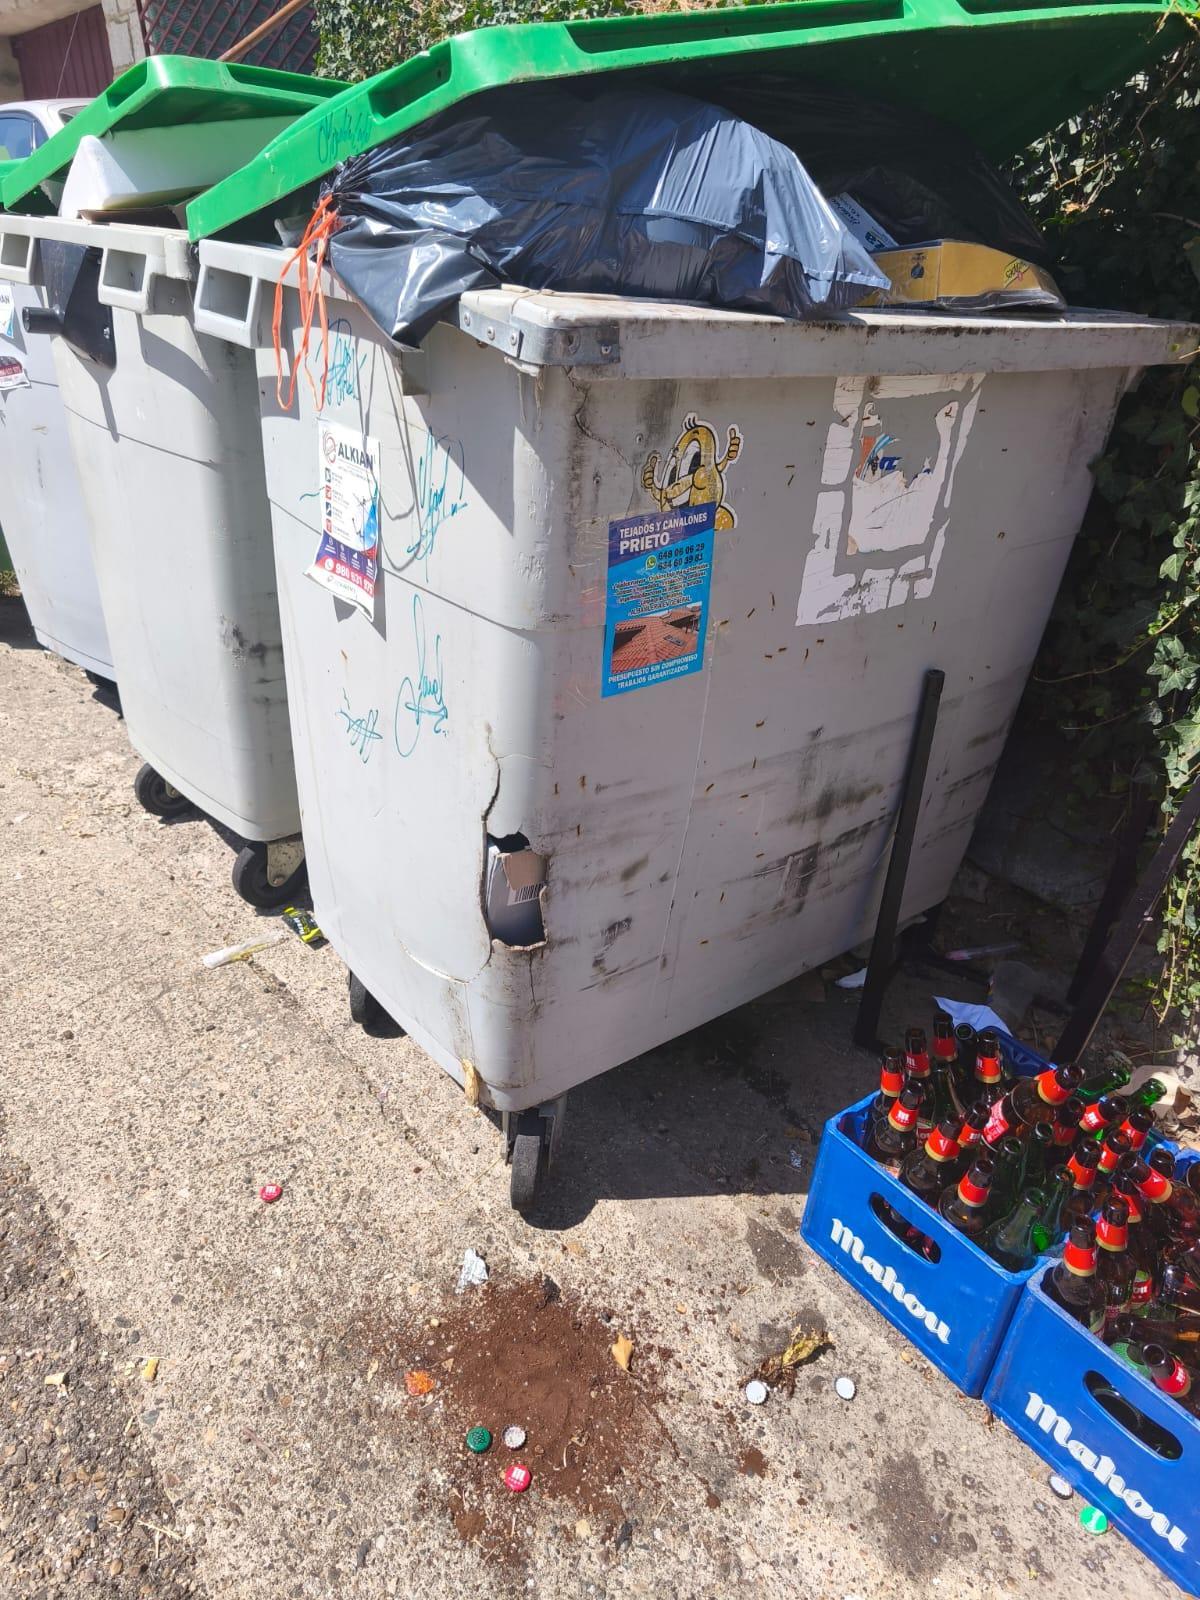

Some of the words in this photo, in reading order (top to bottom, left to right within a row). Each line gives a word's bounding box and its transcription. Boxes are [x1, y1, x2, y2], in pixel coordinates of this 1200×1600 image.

[338, 442, 373, 469] ALKIAN
[620, 523, 654, 538] TEJADOS
[656, 521, 662, 532] Y
[663, 512, 708, 530] CANALONES
[620, 532, 670, 555] PRIETO
[608, 668, 649, 683] PRESUPUESTO
[618, 676, 646, 688] TRABAJOS
[648, 664, 688, 681] GARANTIZADOS
